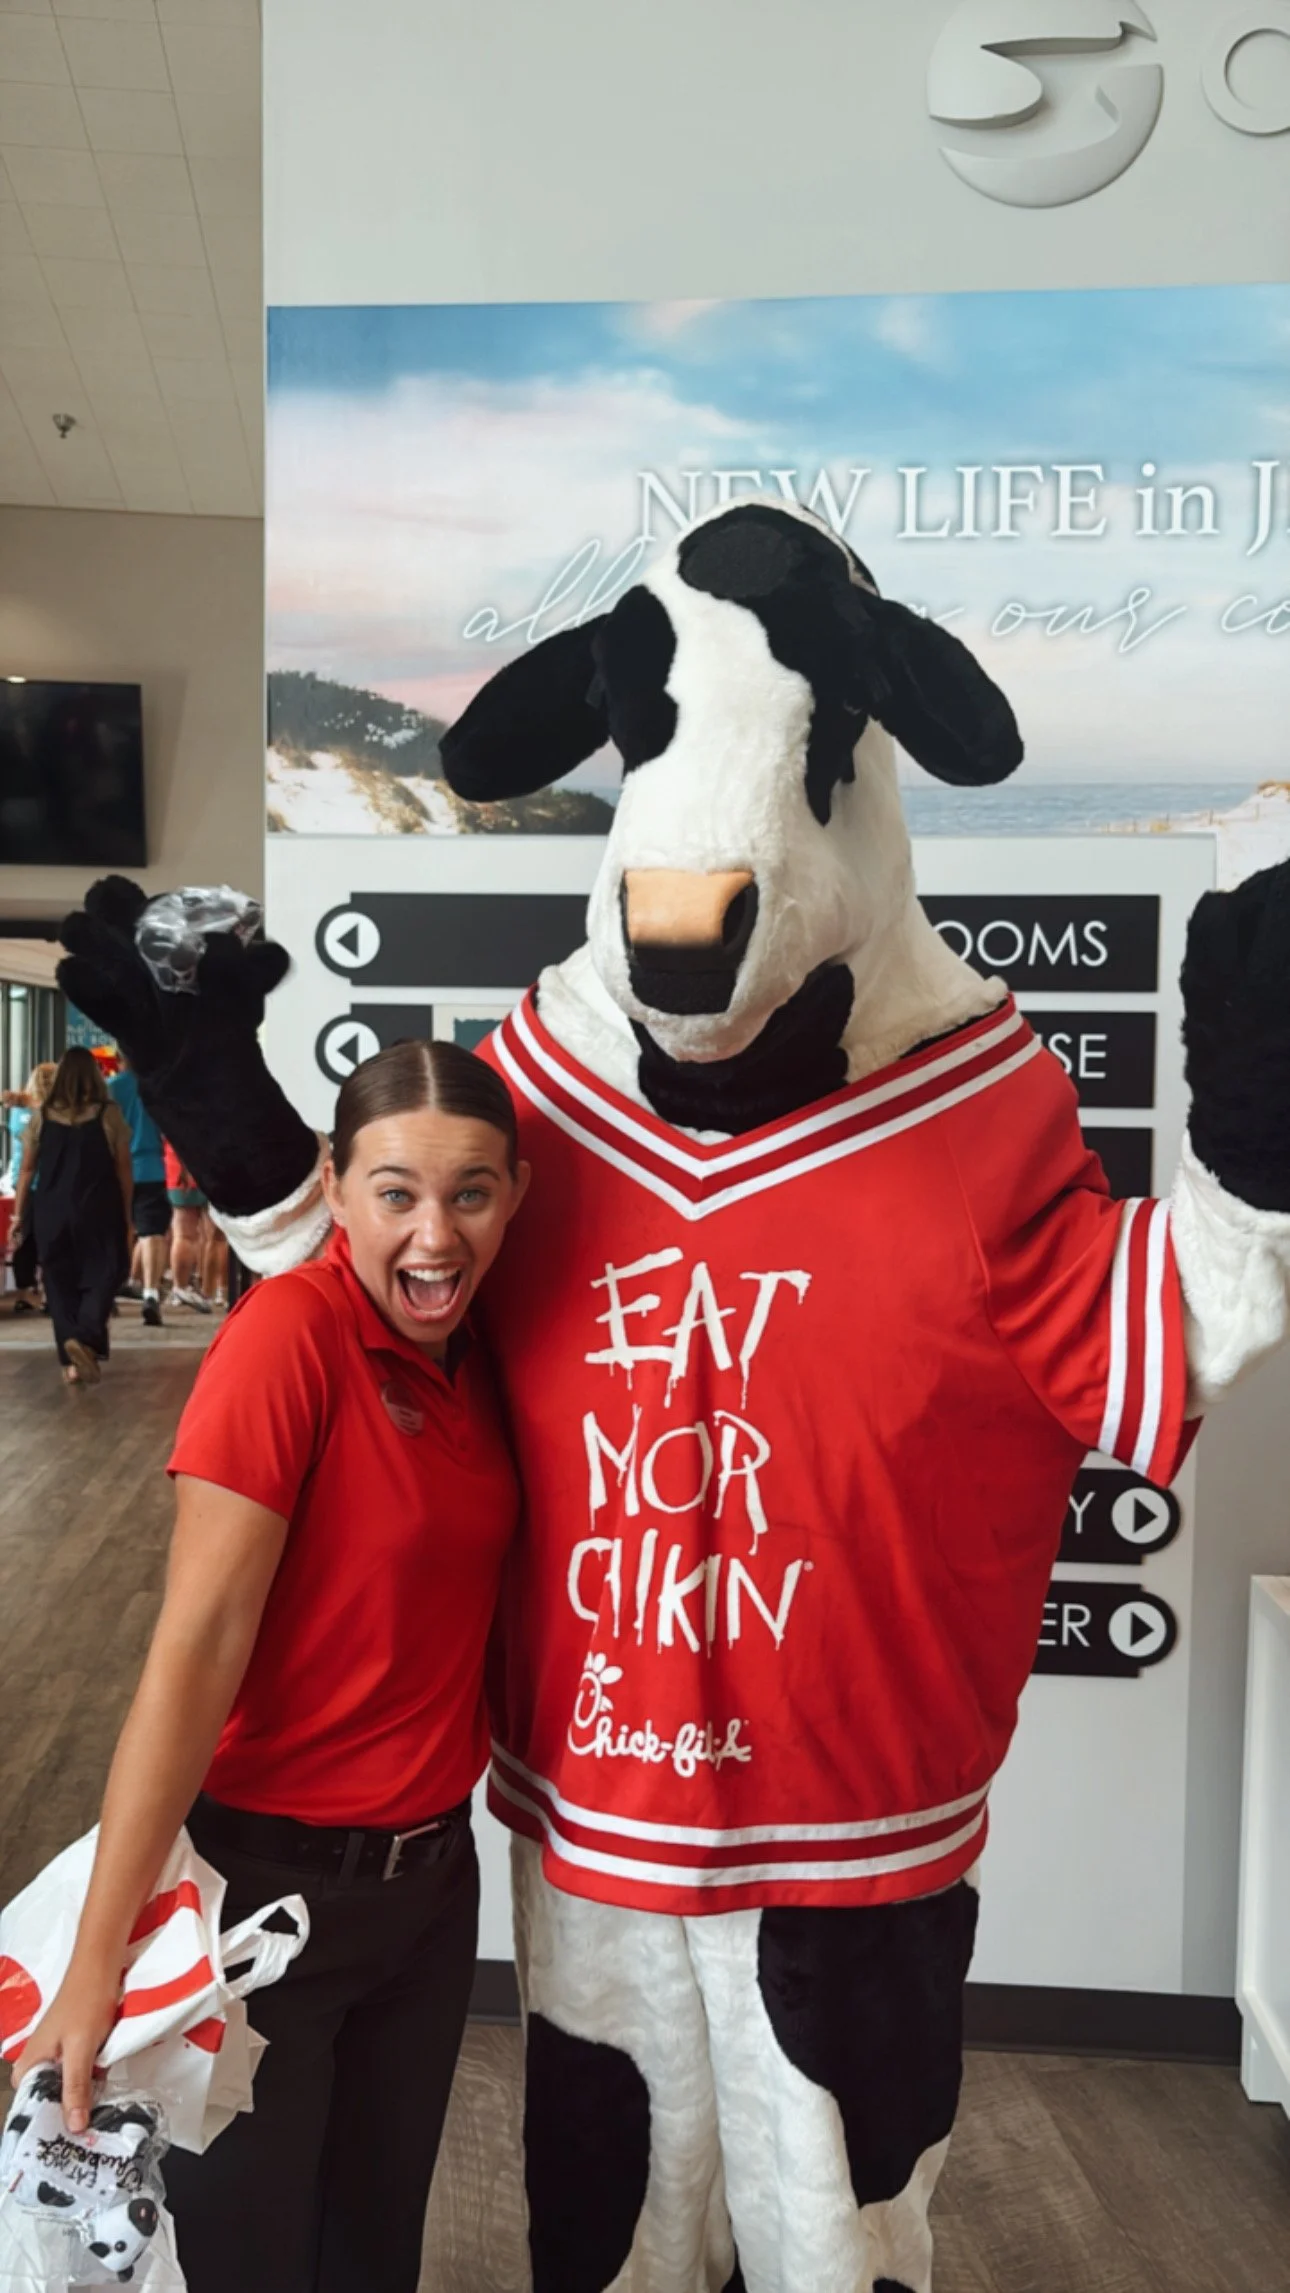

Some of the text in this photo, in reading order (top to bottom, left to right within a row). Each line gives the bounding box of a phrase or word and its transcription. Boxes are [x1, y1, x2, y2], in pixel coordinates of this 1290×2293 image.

[897, 463, 1107, 539] LIFE
[1135, 462, 1220, 535] in
[1246, 460, 1290, 556] J
[462, 538, 646, 645] all
[991, 587, 1188, 653] our
[1036, 1032, 1108, 1079] SE
[585, 1246, 812, 1410] EAT
[582, 1403, 771, 1556] MOR
